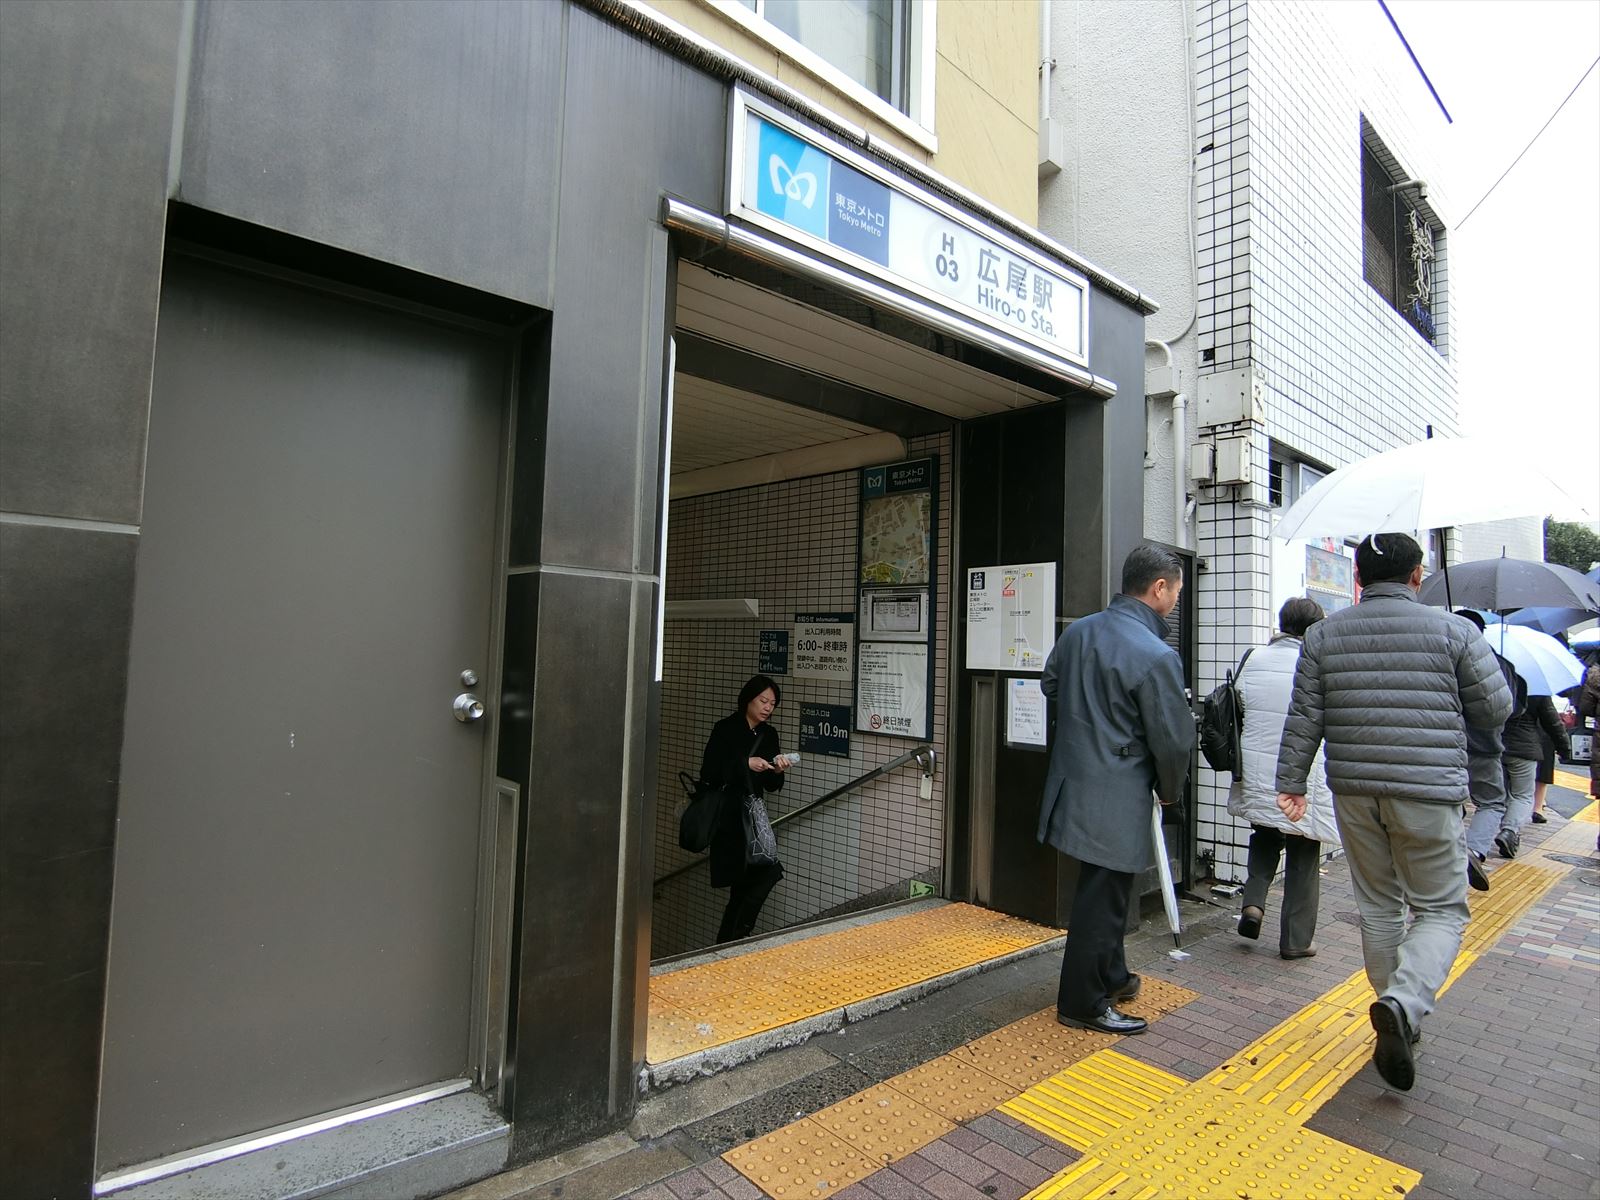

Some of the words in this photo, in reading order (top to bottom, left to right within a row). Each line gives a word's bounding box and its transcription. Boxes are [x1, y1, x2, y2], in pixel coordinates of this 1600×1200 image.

[835, 192, 885, 228] 東京メトロ
[838, 208, 859, 227] Tokyo
[860, 220, 882, 238] Metro
[942, 232, 955, 256] H
[936, 254, 959, 282] 03
[977, 248, 1053, 313] 広尾駅
[977, 284, 1026, 323] Hiro-o
[1031, 310, 1057, 338] Sta.
[892, 467, 924, 480] 東京メトロ
[804, 628, 842, 636] 出入口利用時間
[760, 662, 773, 671] Left
[801, 707, 831, 717] この出入口は
[882, 715, 912, 728] 終日禁煙
[818, 721, 849, 739] 10.9m
